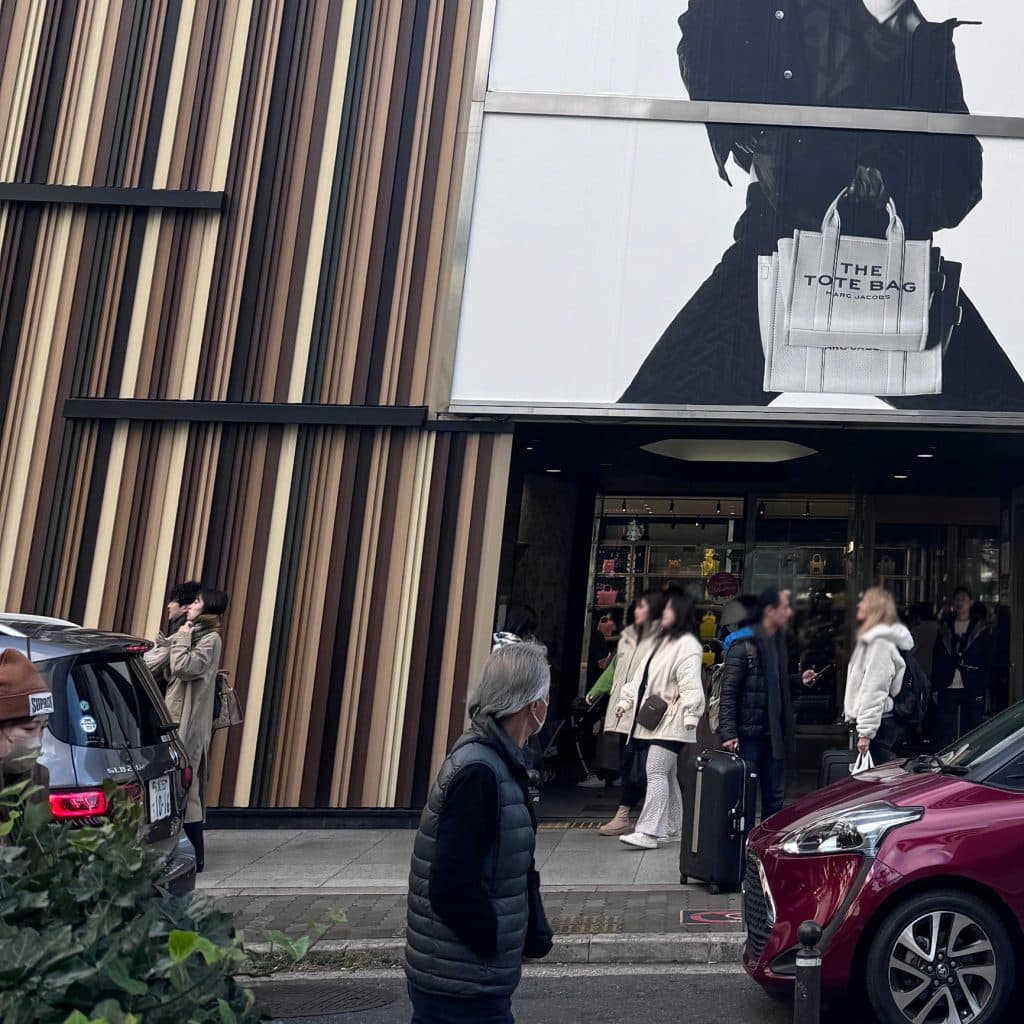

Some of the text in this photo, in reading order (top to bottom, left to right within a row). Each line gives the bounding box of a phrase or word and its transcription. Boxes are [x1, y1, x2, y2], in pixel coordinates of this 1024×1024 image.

[840, 262, 882, 277] THE
[803, 274, 917, 293] TOTE BAG
